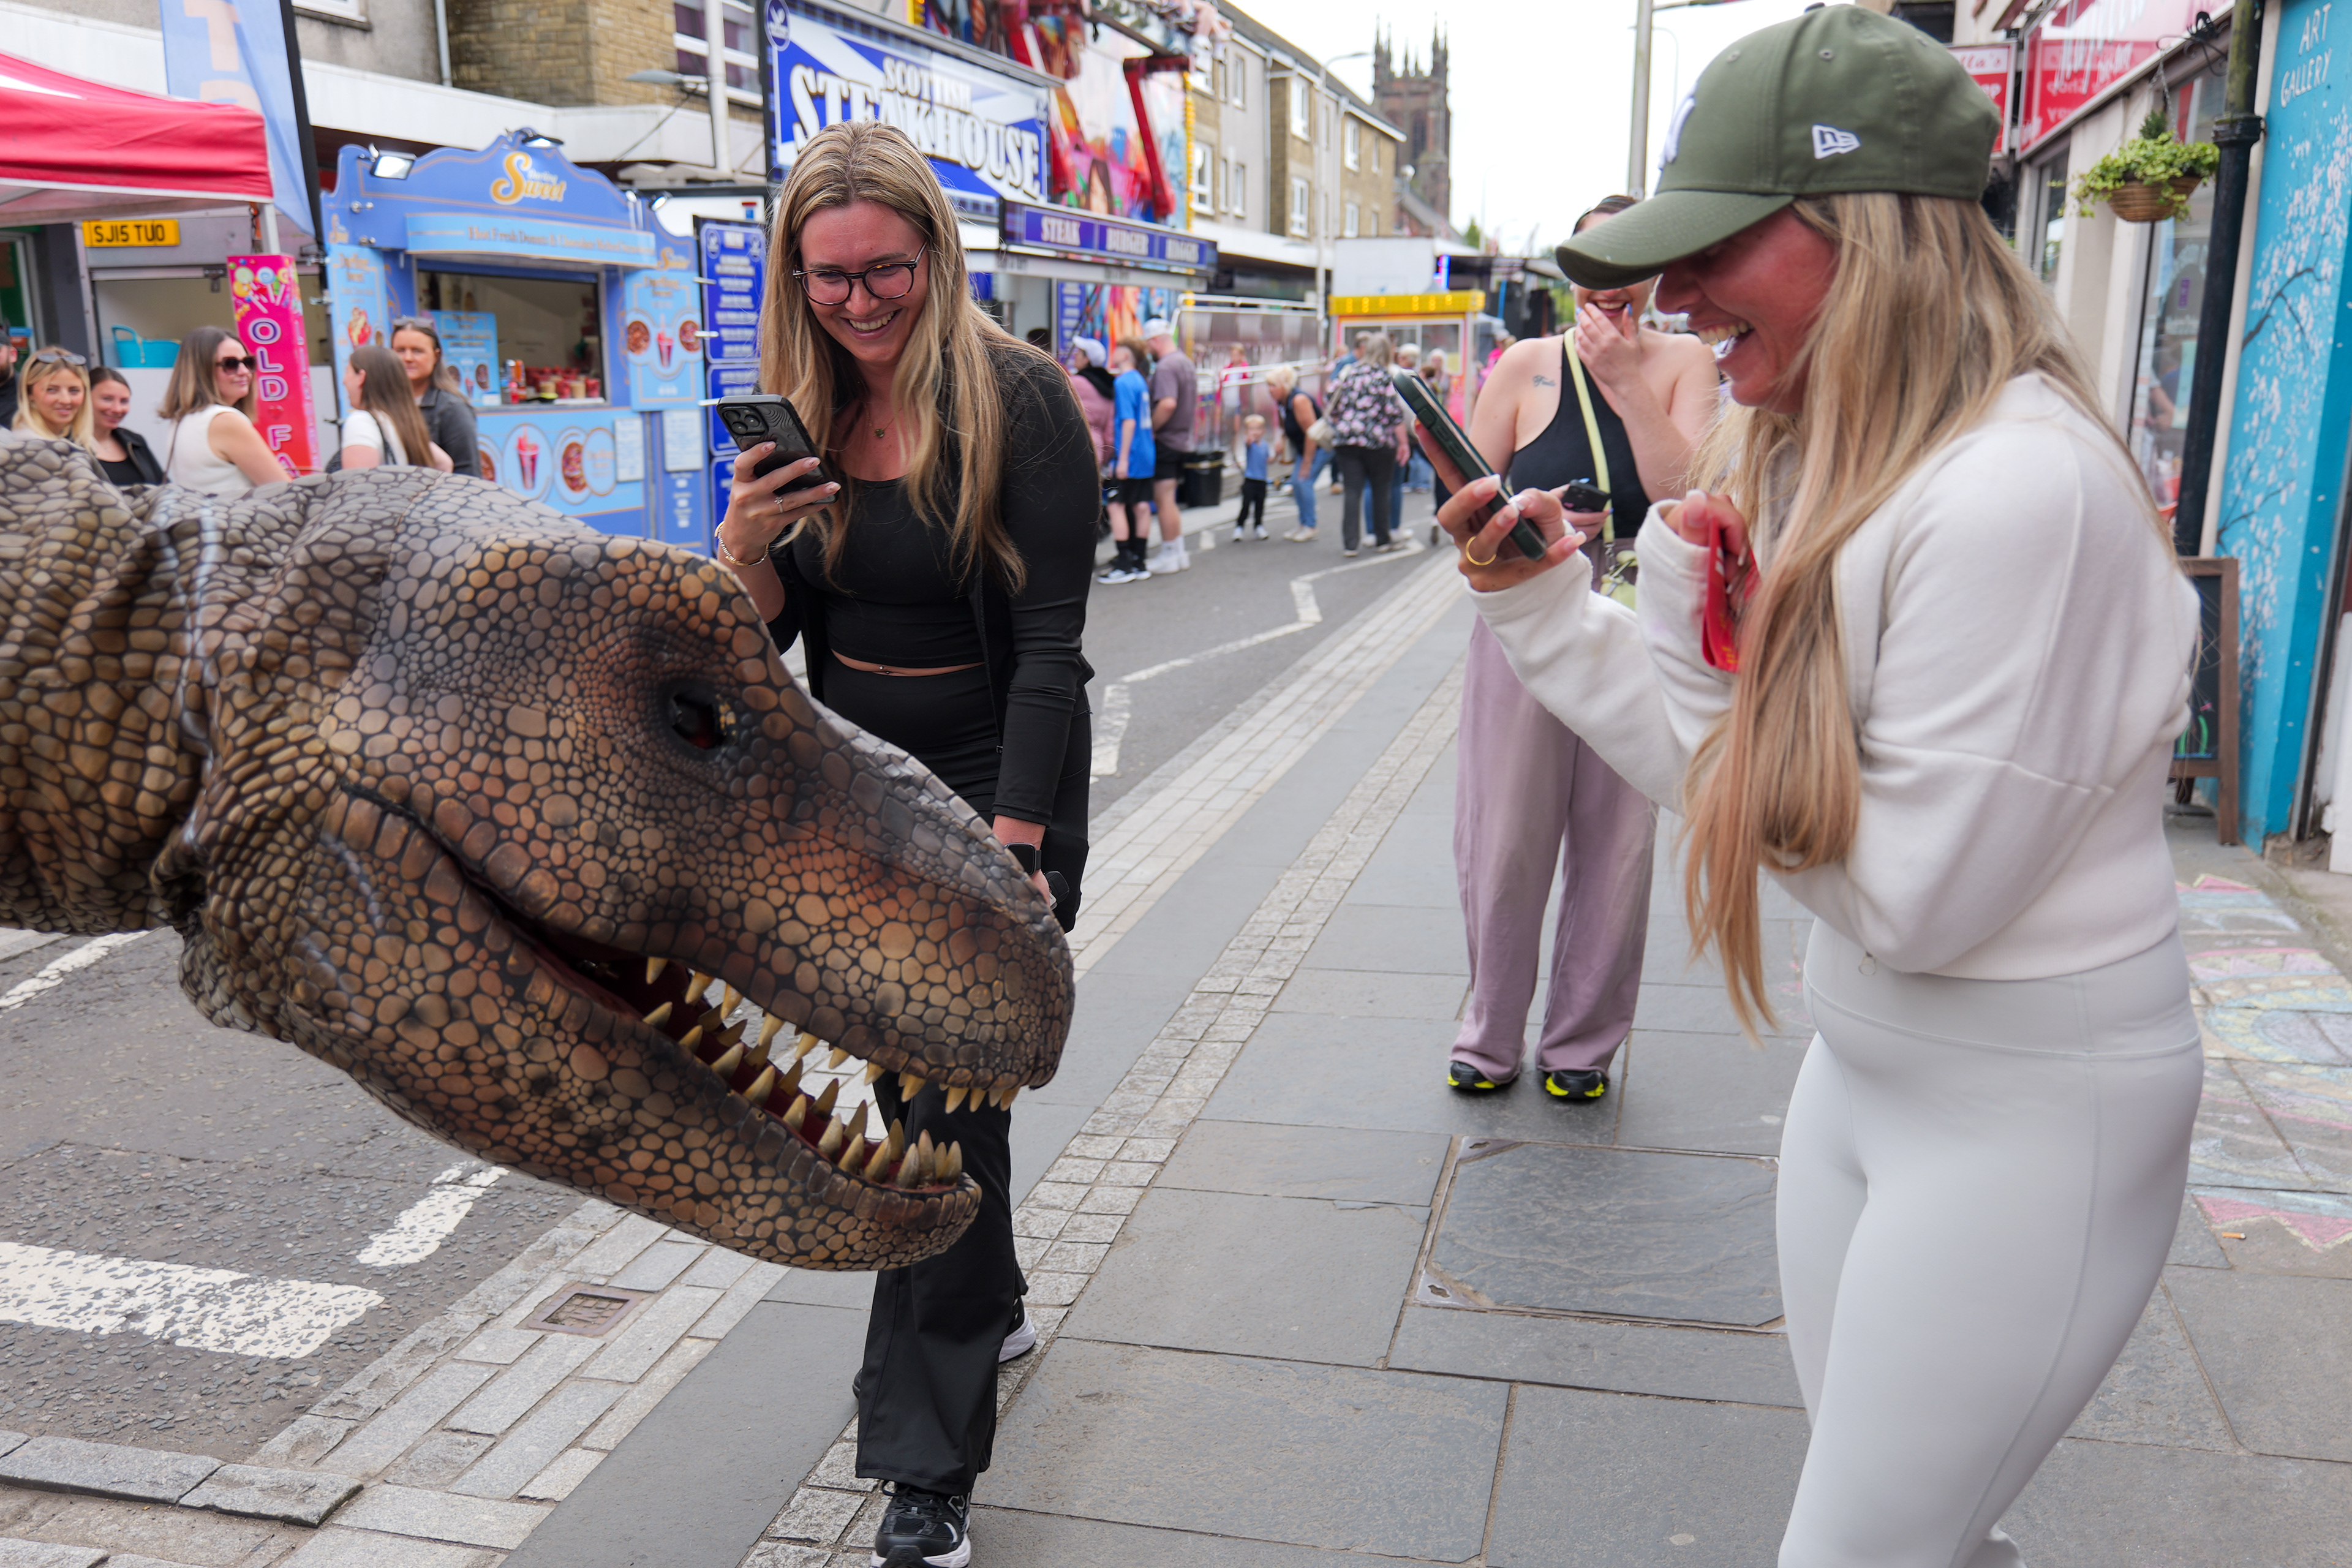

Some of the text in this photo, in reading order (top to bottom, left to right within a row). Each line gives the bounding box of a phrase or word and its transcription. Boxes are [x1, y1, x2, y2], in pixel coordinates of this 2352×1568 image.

[2299, 2, 2332, 56] ART
[882, 56, 972, 113] SCOTTISH
[2280, 47, 2332, 108] GALLERY
[491, 151, 567, 205] Sweet
[94, 225, 130, 242] SJ15
[1041, 215, 1081, 246] STEAK
[248, 317, 288, 402] OLD
